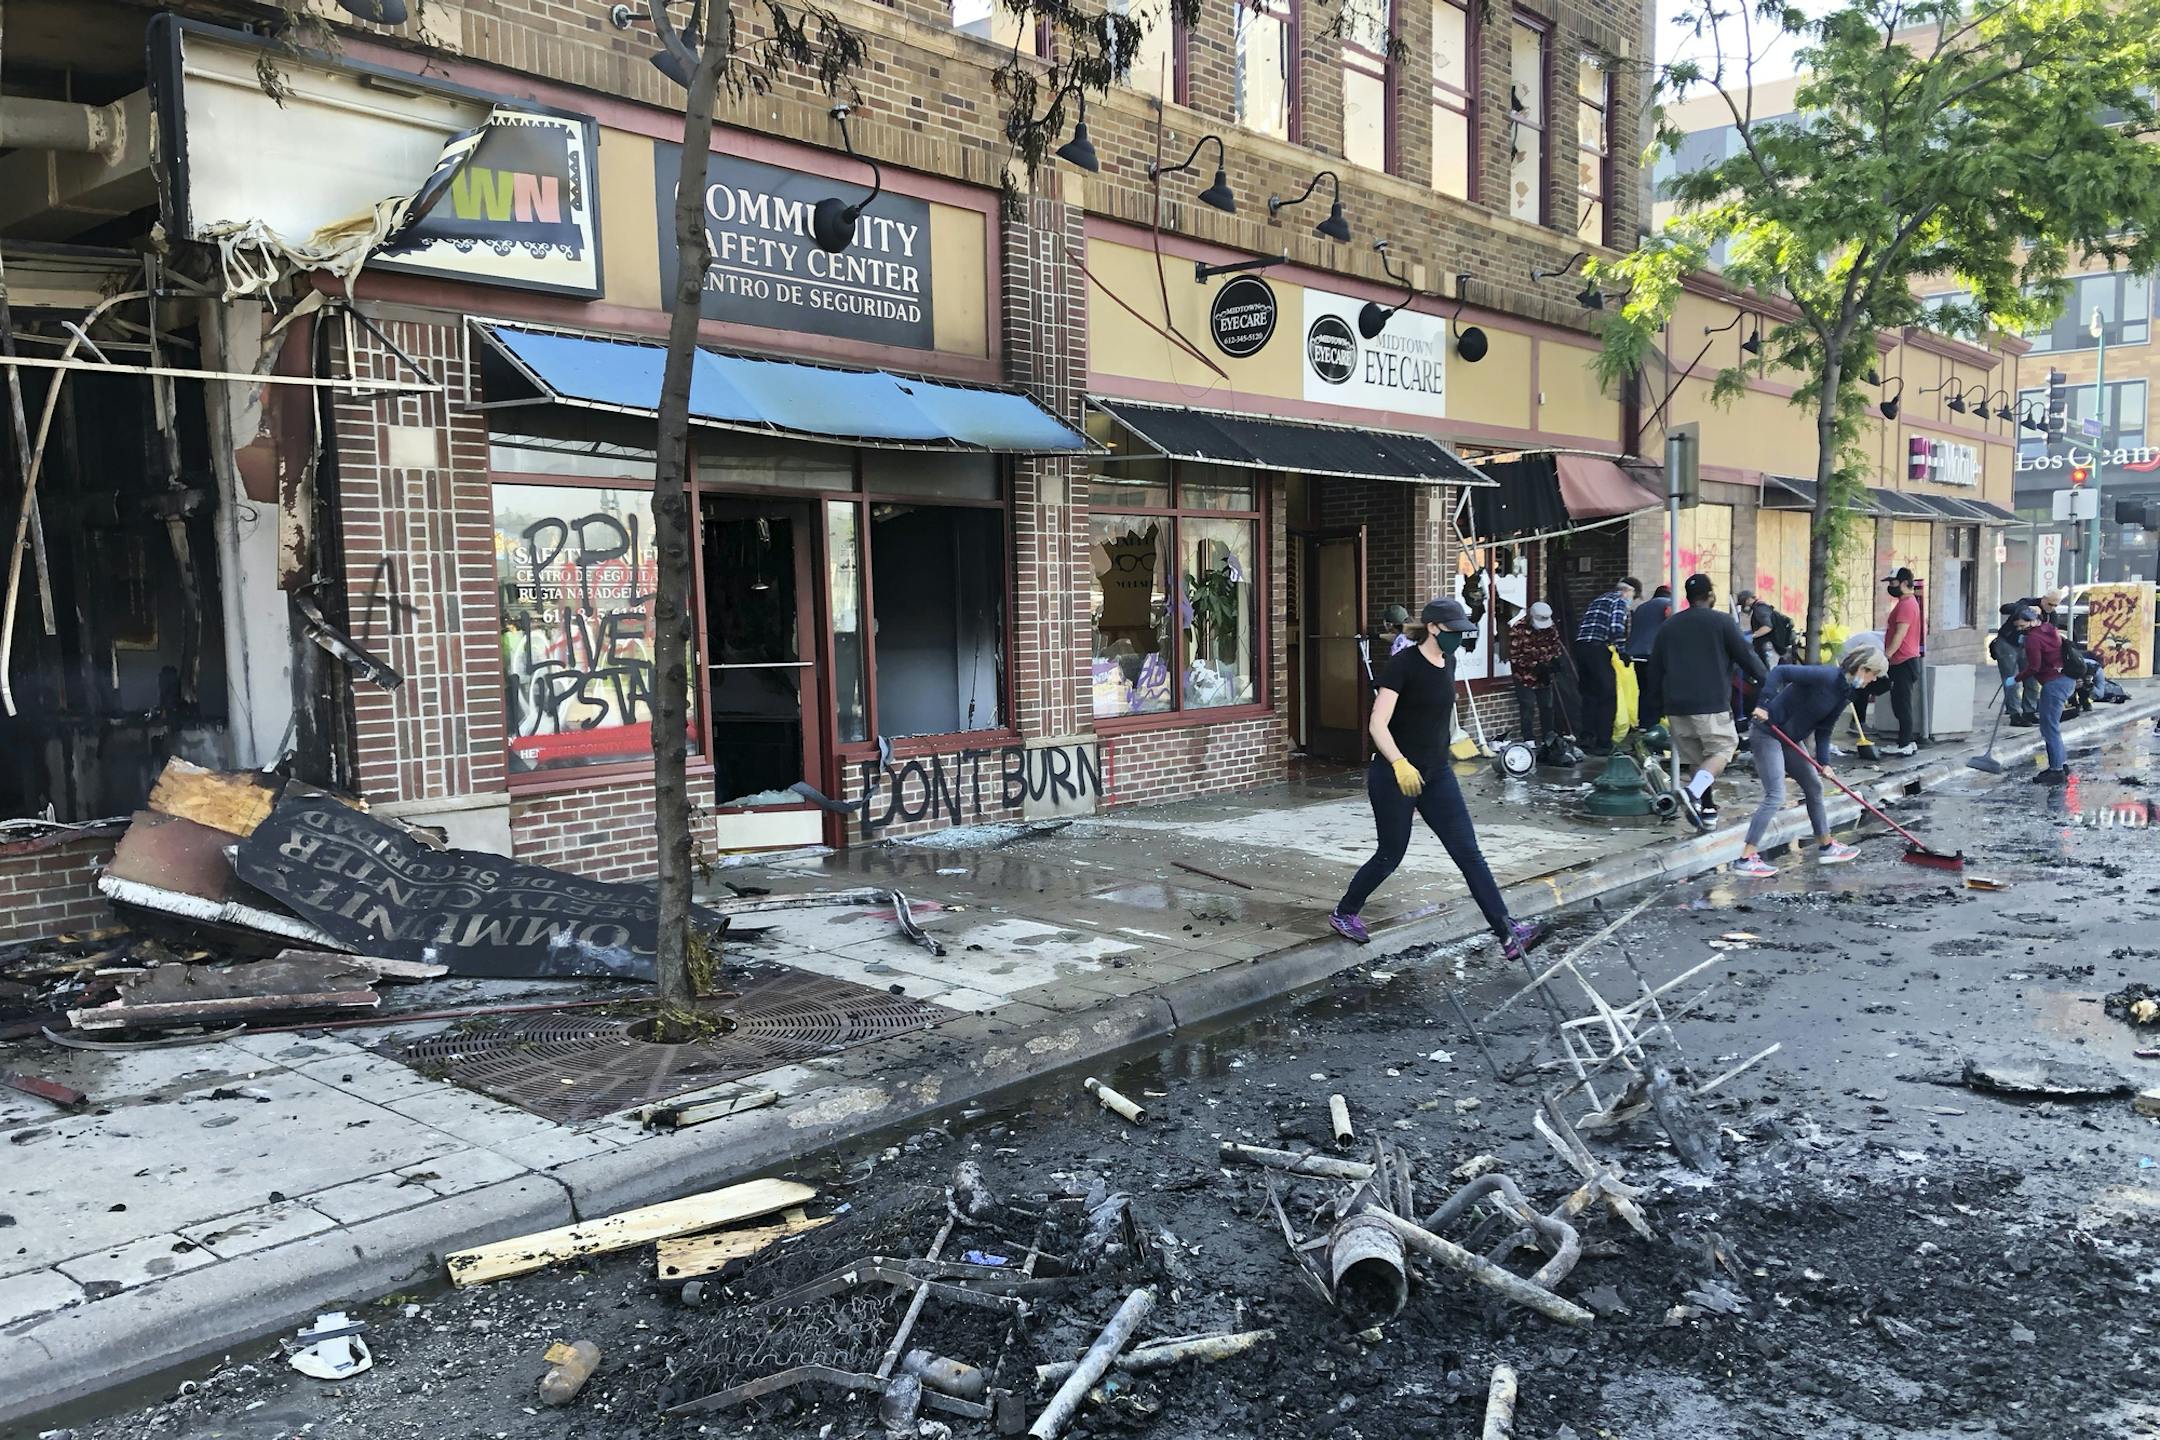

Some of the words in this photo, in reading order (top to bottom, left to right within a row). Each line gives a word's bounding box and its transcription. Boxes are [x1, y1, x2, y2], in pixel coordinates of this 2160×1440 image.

[451, 167, 561, 223] WN
[675, 182, 918, 257] OMMITY
[677, 227, 798, 272] AFETY
[807, 249, 919, 293] CENTER
[701, 273, 769, 299] ENTRO
[776, 284, 803, 306] DE
[809, 290, 921, 323] SEGURIDAD
[1226, 303, 1260, 315] MIDTOWN
[1376, 333, 1433, 356] MIDTOWN
[2016, 452, 2063, 472] Los
[496, 892, 657, 923] AFETY
